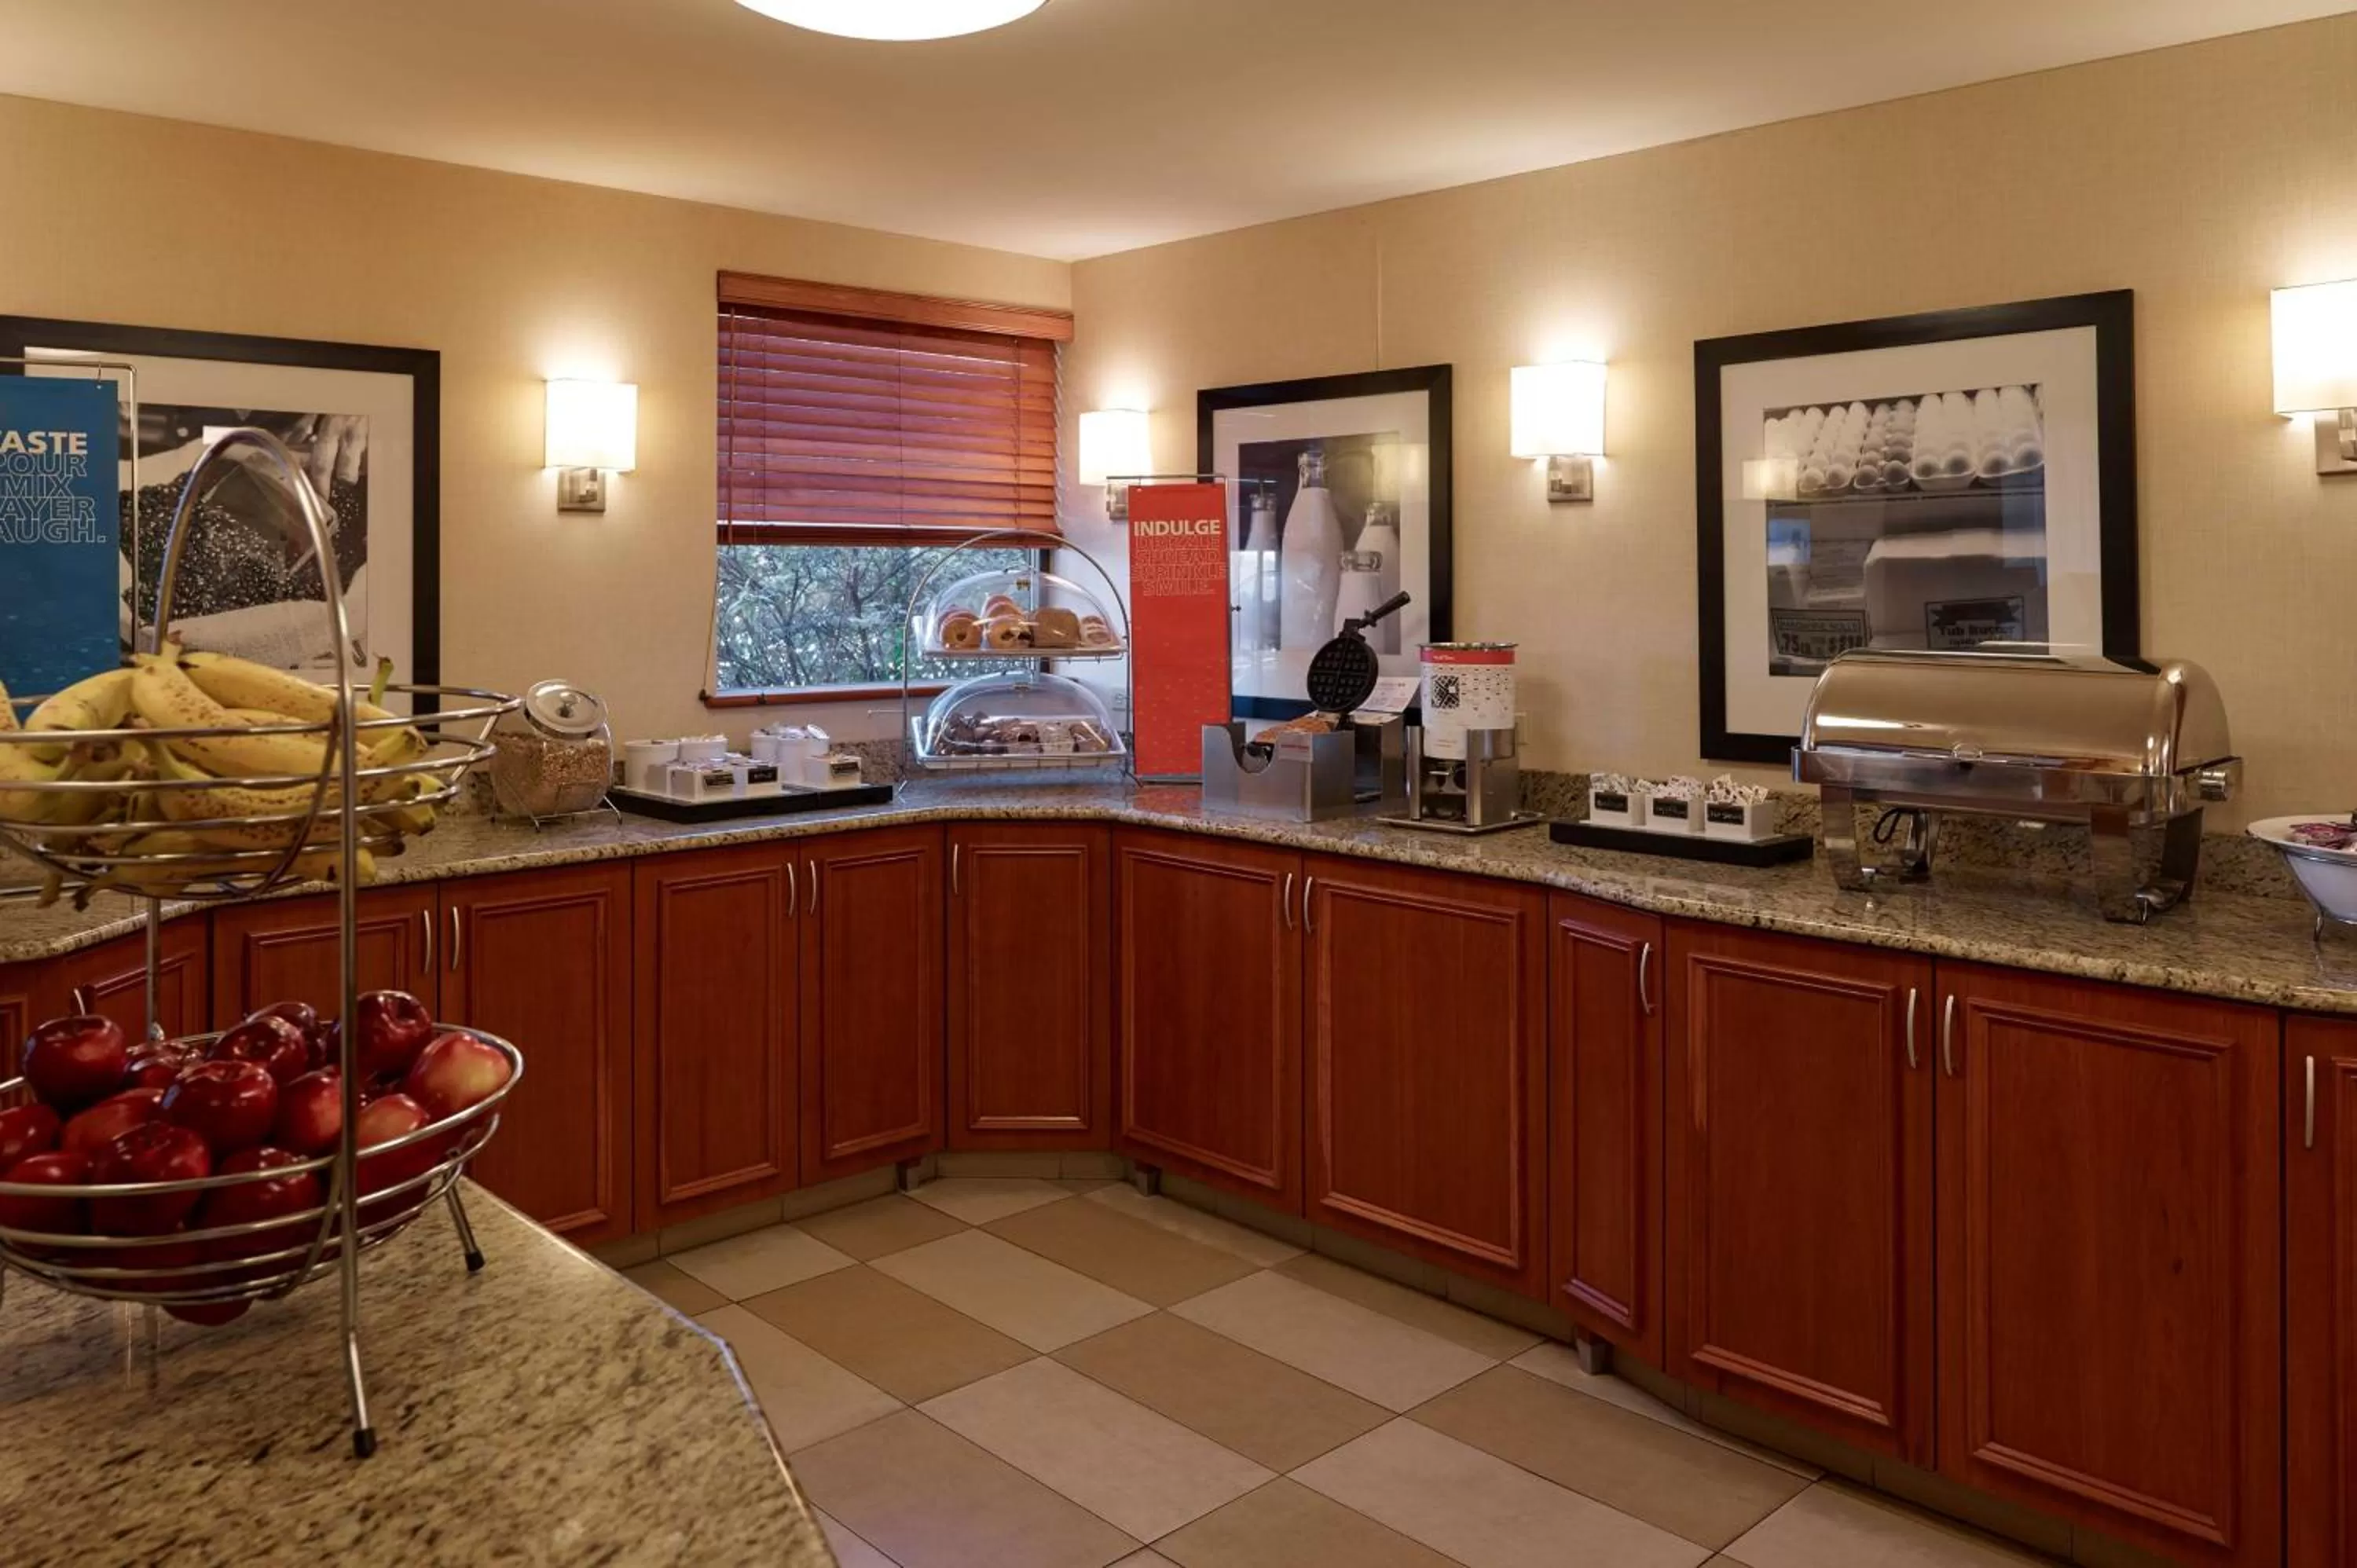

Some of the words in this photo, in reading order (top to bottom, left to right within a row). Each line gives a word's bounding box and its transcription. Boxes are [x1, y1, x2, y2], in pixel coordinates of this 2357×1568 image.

[0, 430, 88, 455] ASTE
[0, 496, 96, 521] AYER
[0, 518, 108, 544] AUGH.
[1134, 519, 1222, 537] INDULGE
